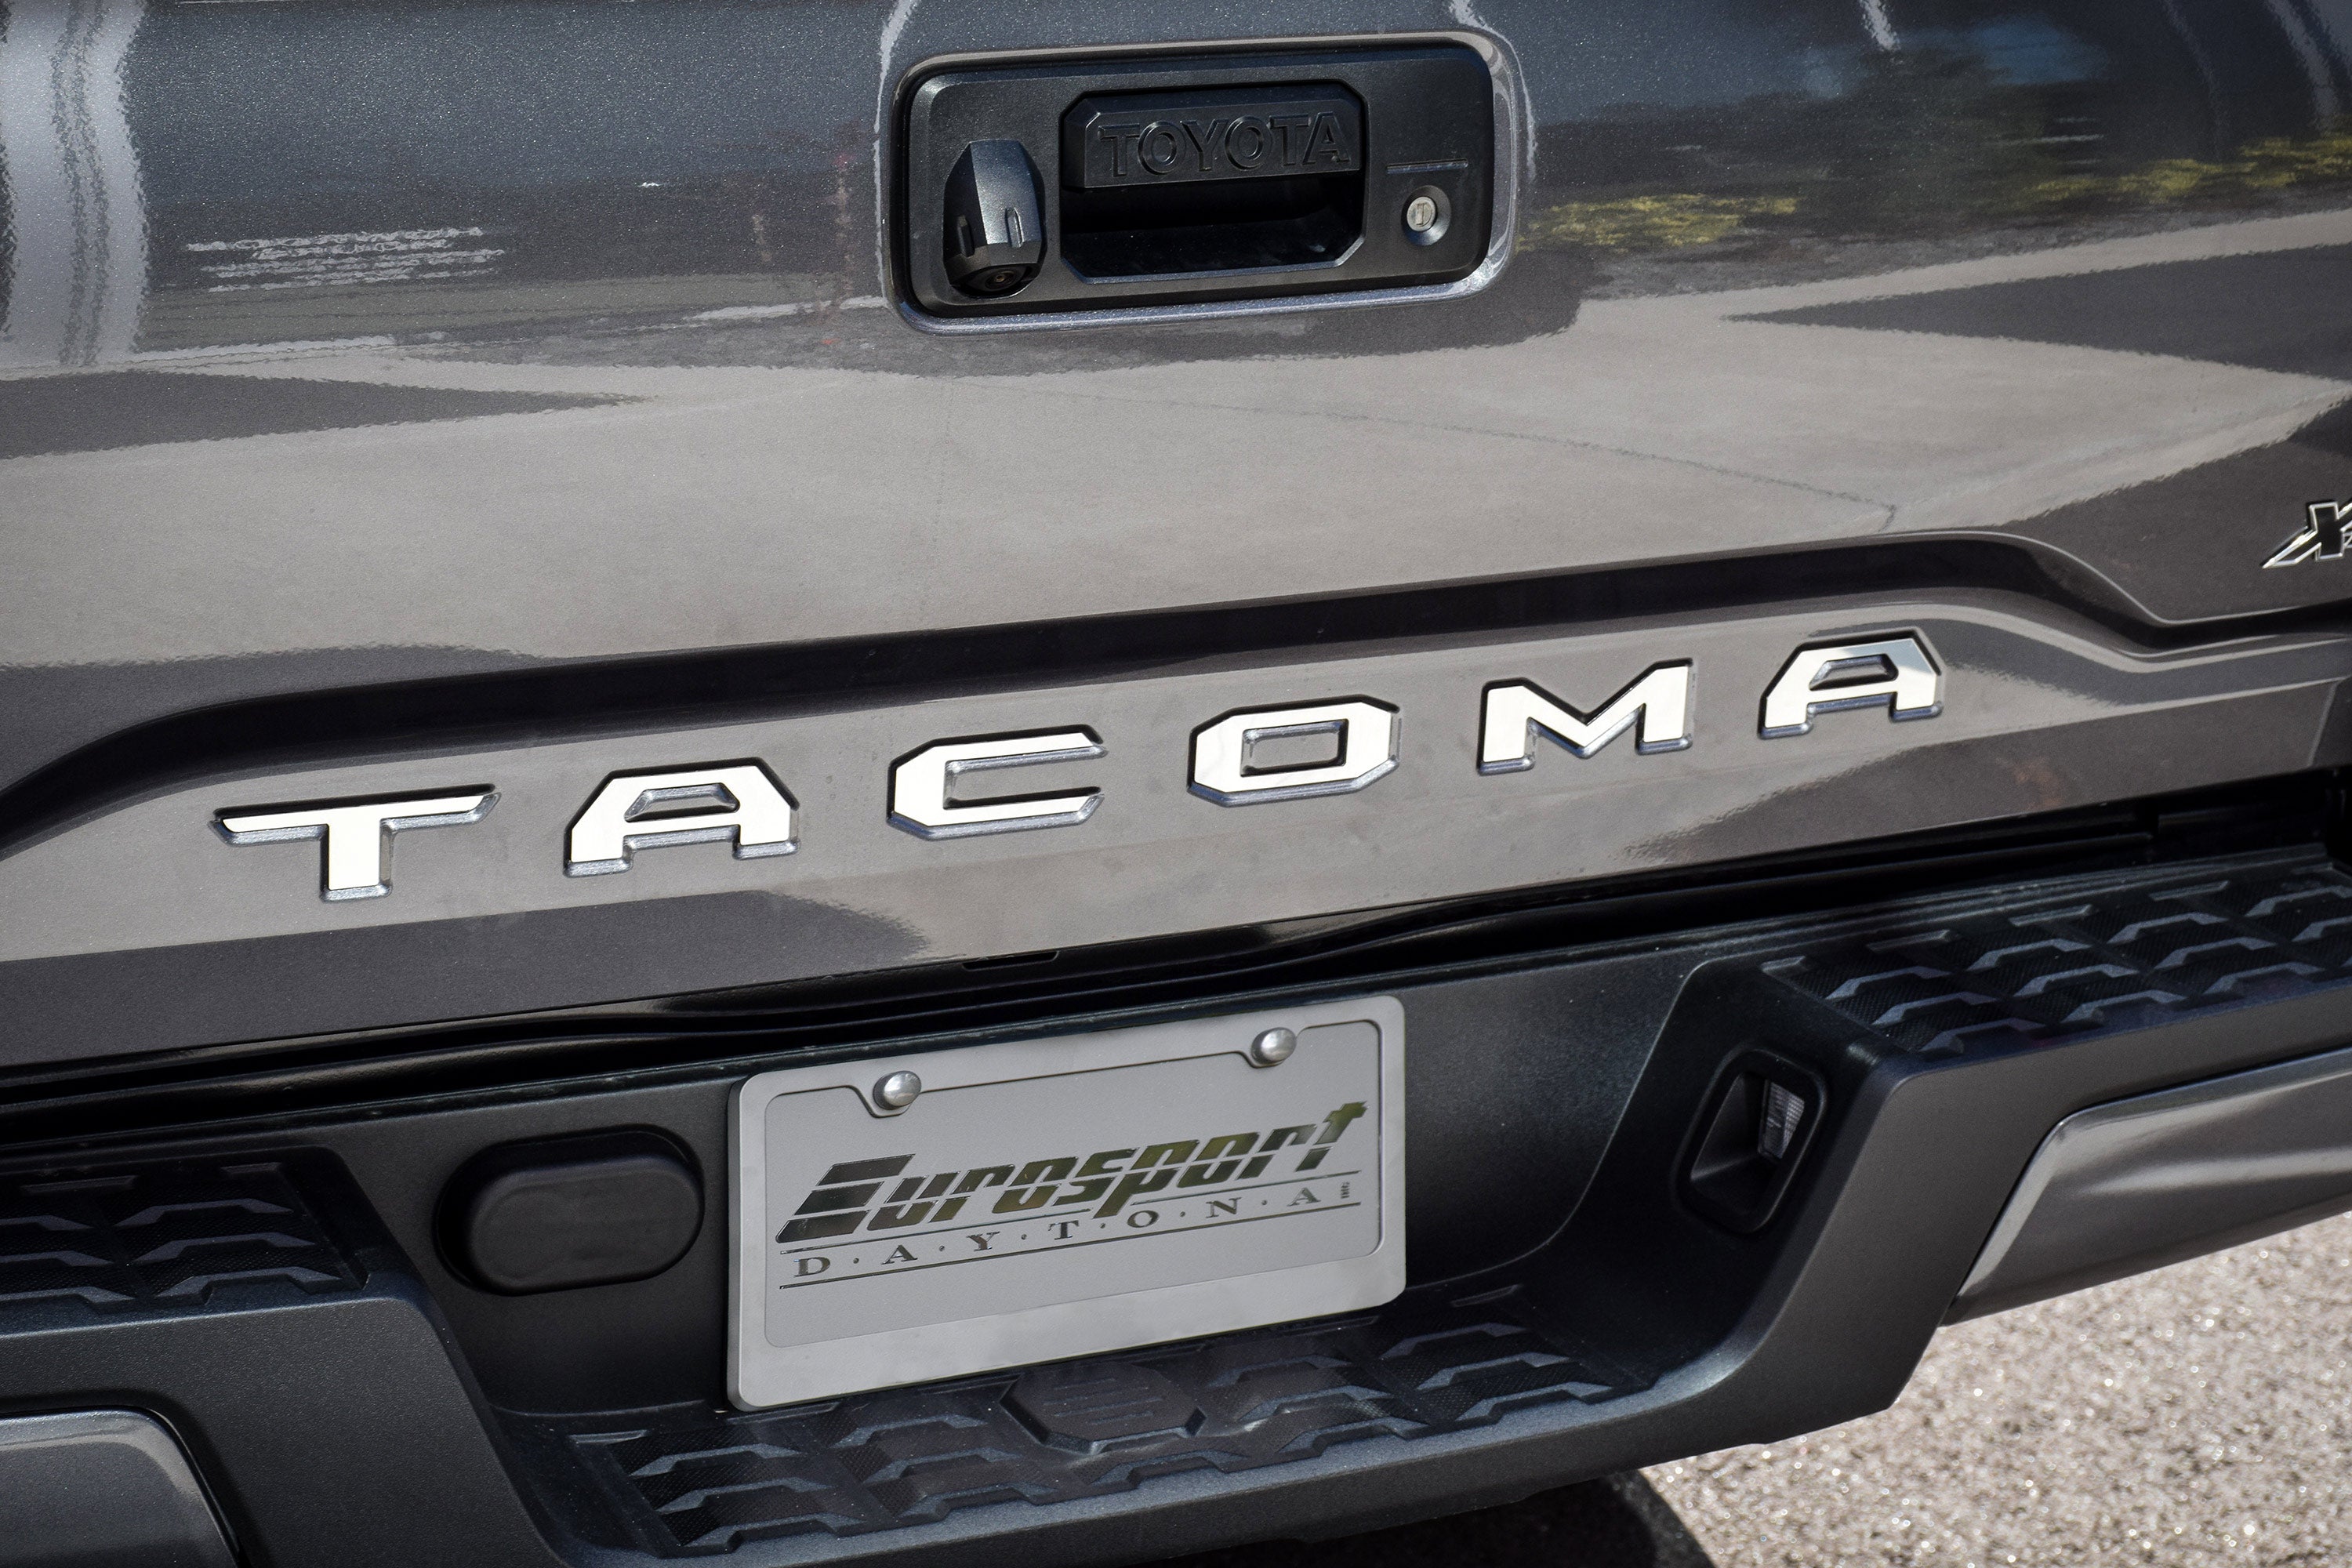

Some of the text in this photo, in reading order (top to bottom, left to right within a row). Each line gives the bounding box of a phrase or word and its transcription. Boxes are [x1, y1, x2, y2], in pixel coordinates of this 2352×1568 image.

[1098, 111, 1352, 178] TOYOTA
[210, 630, 1944, 902] TACOMA
[775, 1100, 1368, 1243] Eurosport
